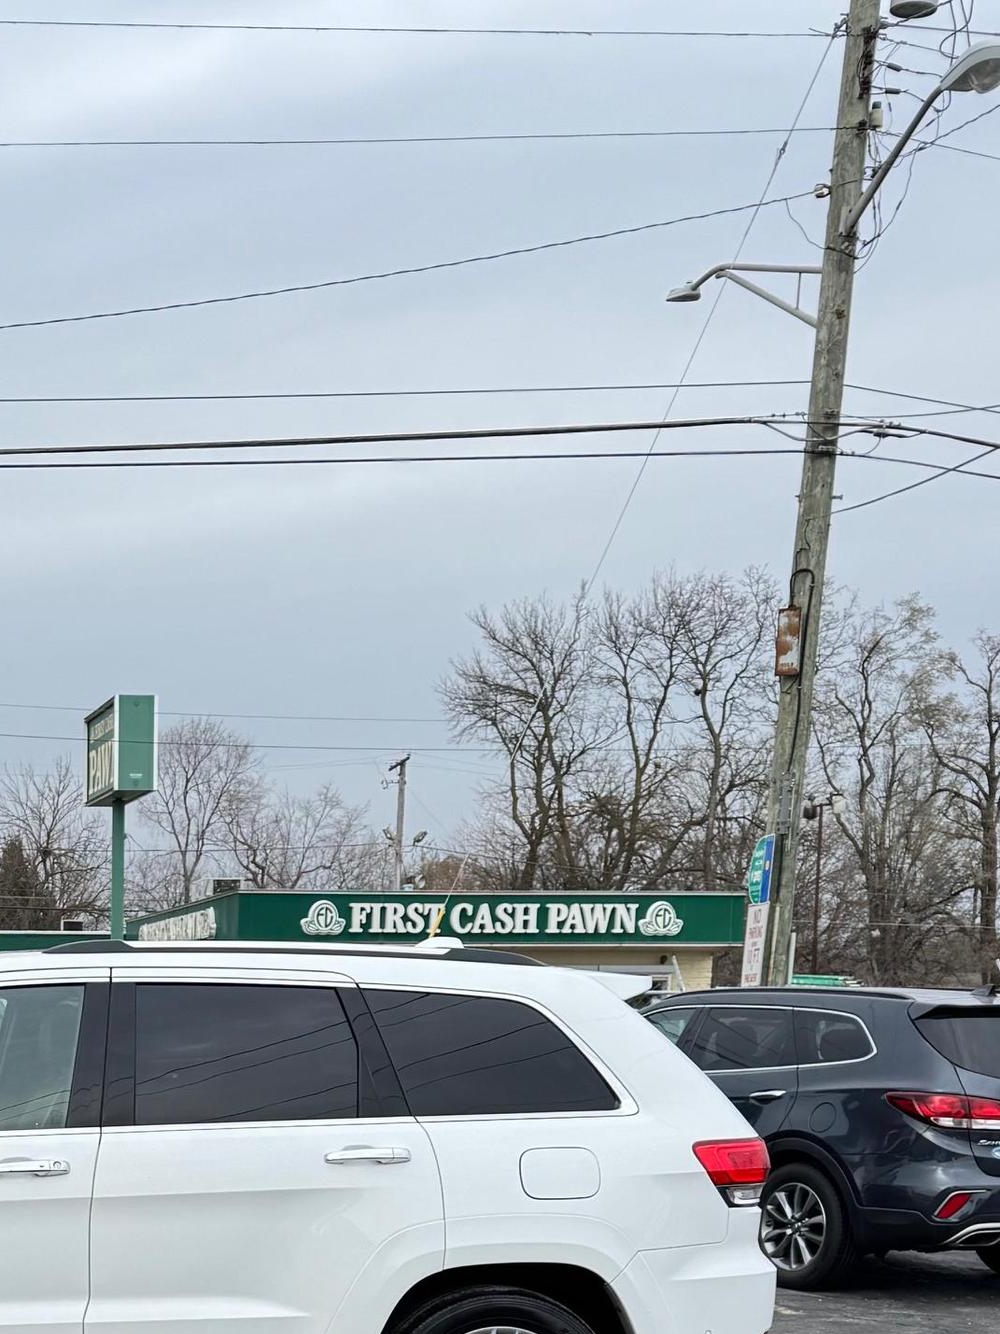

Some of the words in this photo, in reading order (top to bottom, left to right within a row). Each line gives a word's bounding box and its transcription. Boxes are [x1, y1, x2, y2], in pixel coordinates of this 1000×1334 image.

[348, 903, 446, 934] FIRST
[450, 903, 540, 934] CASH
[545, 903, 639, 934] PAWN
